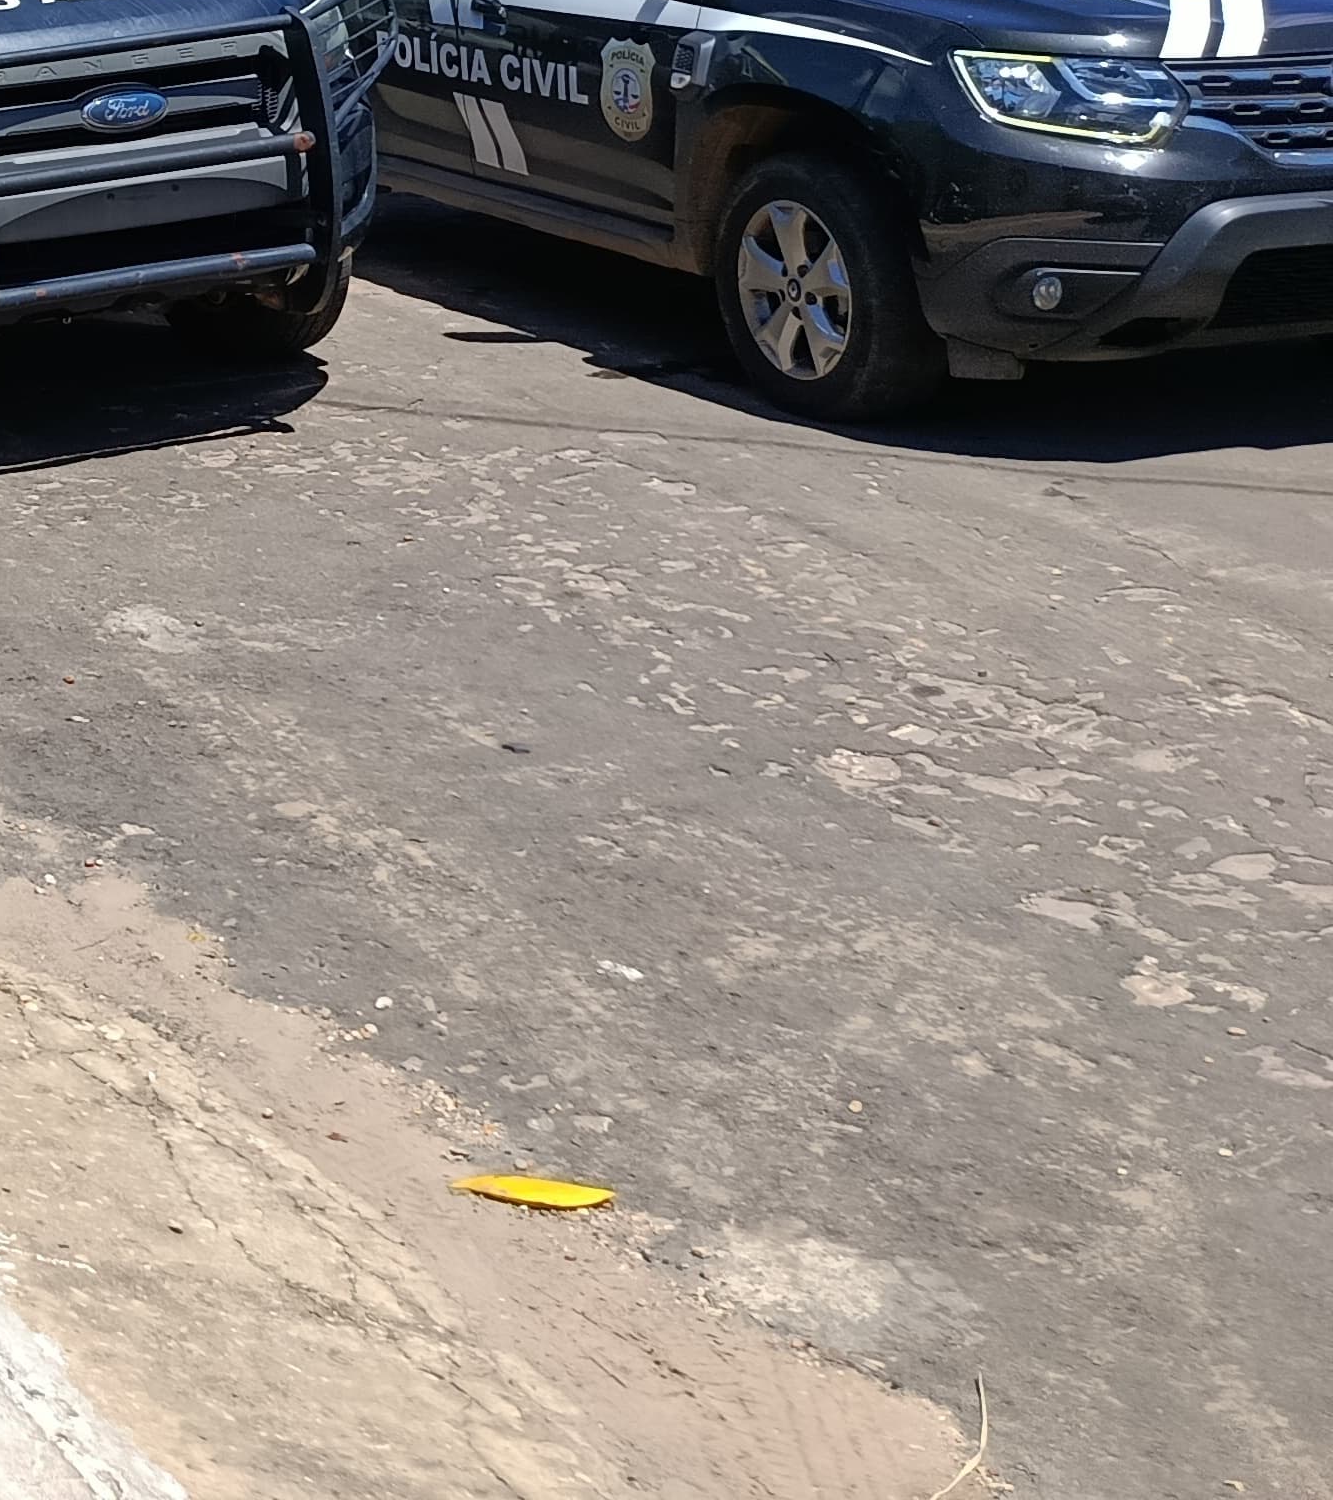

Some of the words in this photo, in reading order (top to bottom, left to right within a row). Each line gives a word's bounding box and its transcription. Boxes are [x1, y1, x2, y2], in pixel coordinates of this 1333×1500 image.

[376, 31, 493, 86] POLÍCIA
[499, 53, 589, 105] CIVIL
[104, 97, 150, 122] Ford
[614, 117, 641, 131] CIVIL
